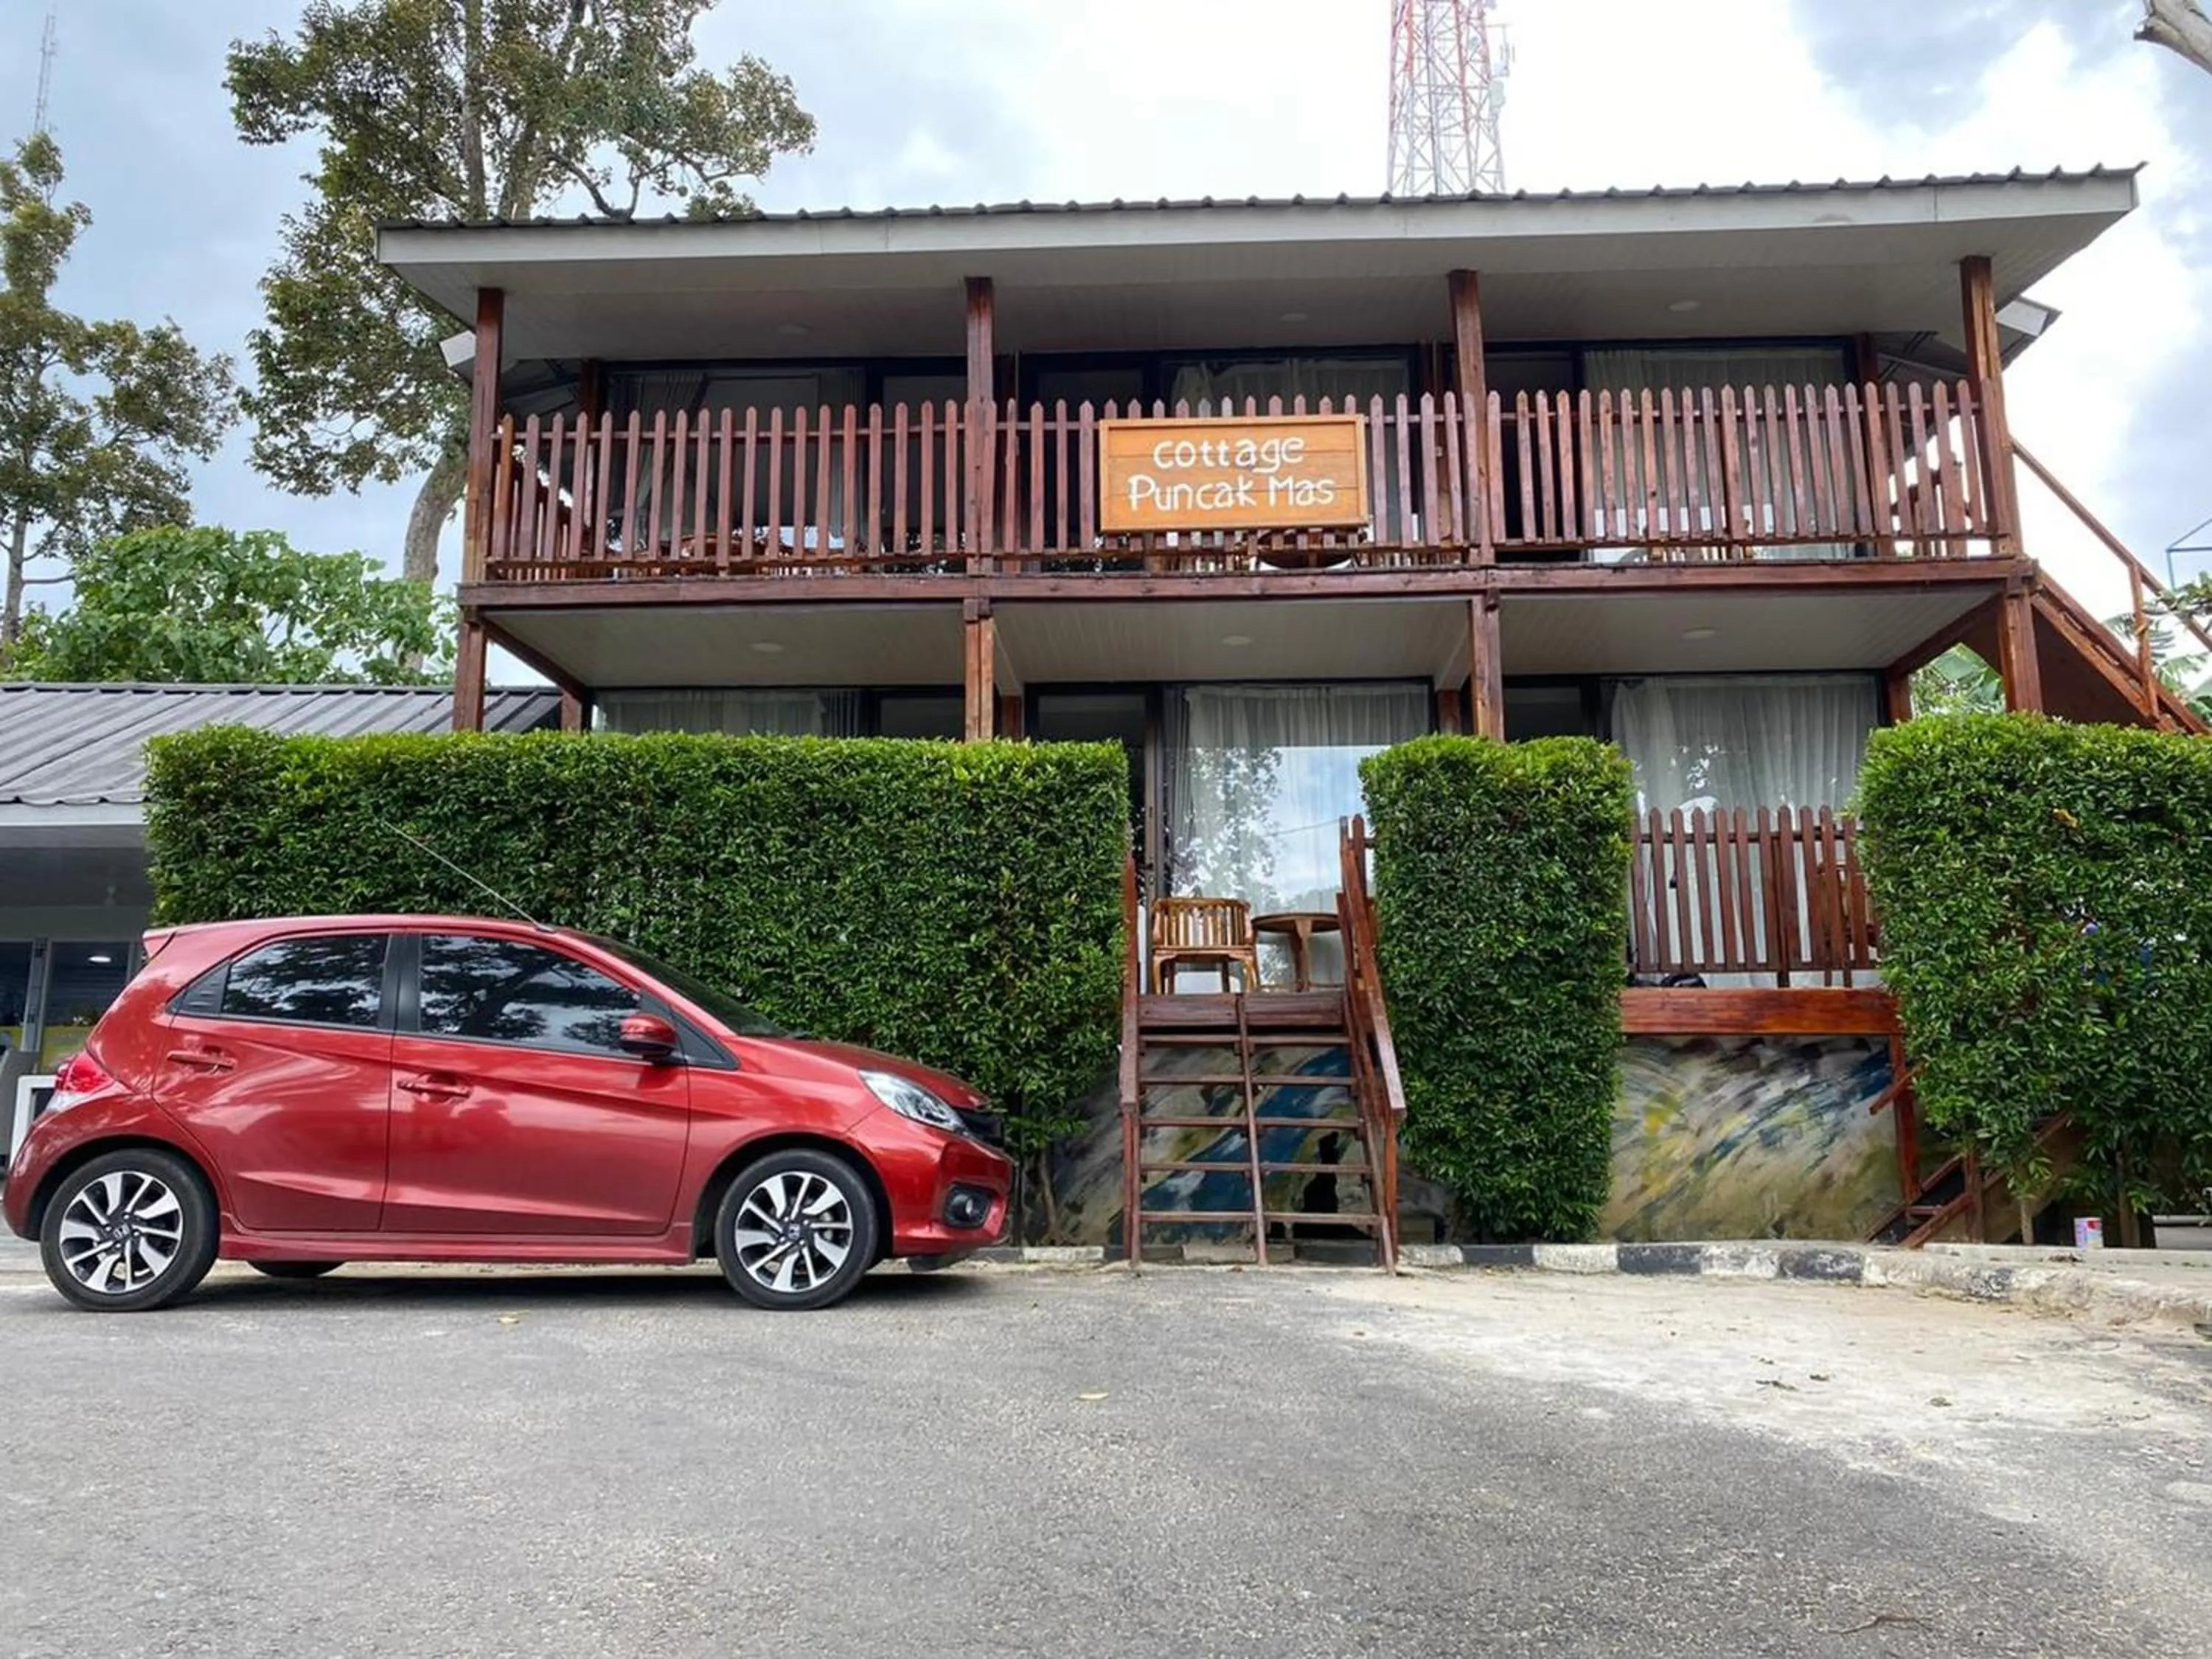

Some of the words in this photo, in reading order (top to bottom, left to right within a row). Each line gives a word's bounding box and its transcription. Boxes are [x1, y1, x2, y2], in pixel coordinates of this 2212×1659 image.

[1153, 437, 1304, 473] cottage
[1128, 474, 1256, 511] Puncak
[1267, 476, 1335, 507] Mas
